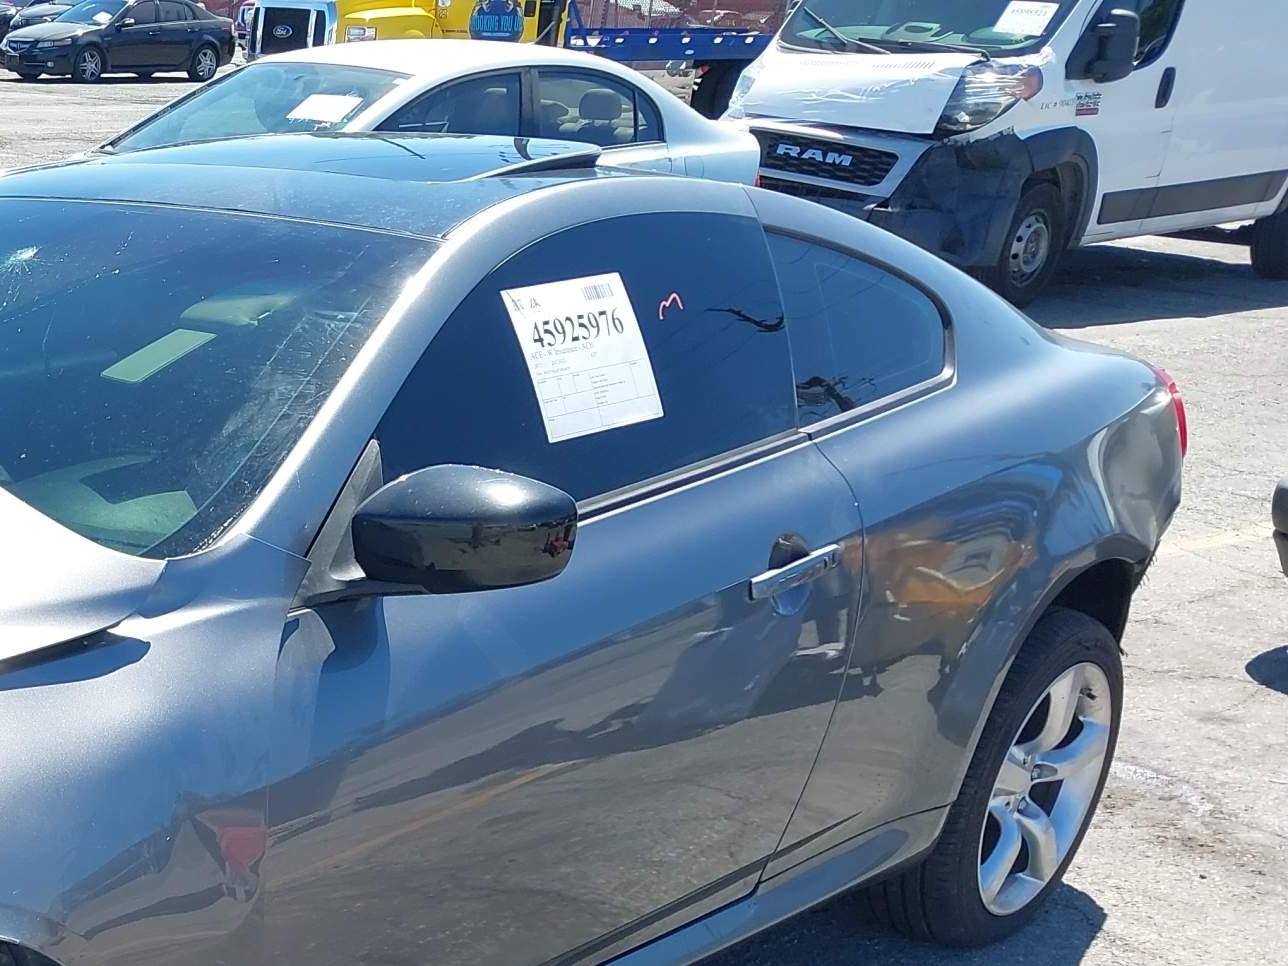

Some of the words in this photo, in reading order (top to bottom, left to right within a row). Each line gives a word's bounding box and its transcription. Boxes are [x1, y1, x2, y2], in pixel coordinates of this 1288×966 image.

[500, 15, 513, 32] YOU
[776, 143, 853, 167] RAM
[532, 307, 624, 348] 45925976
